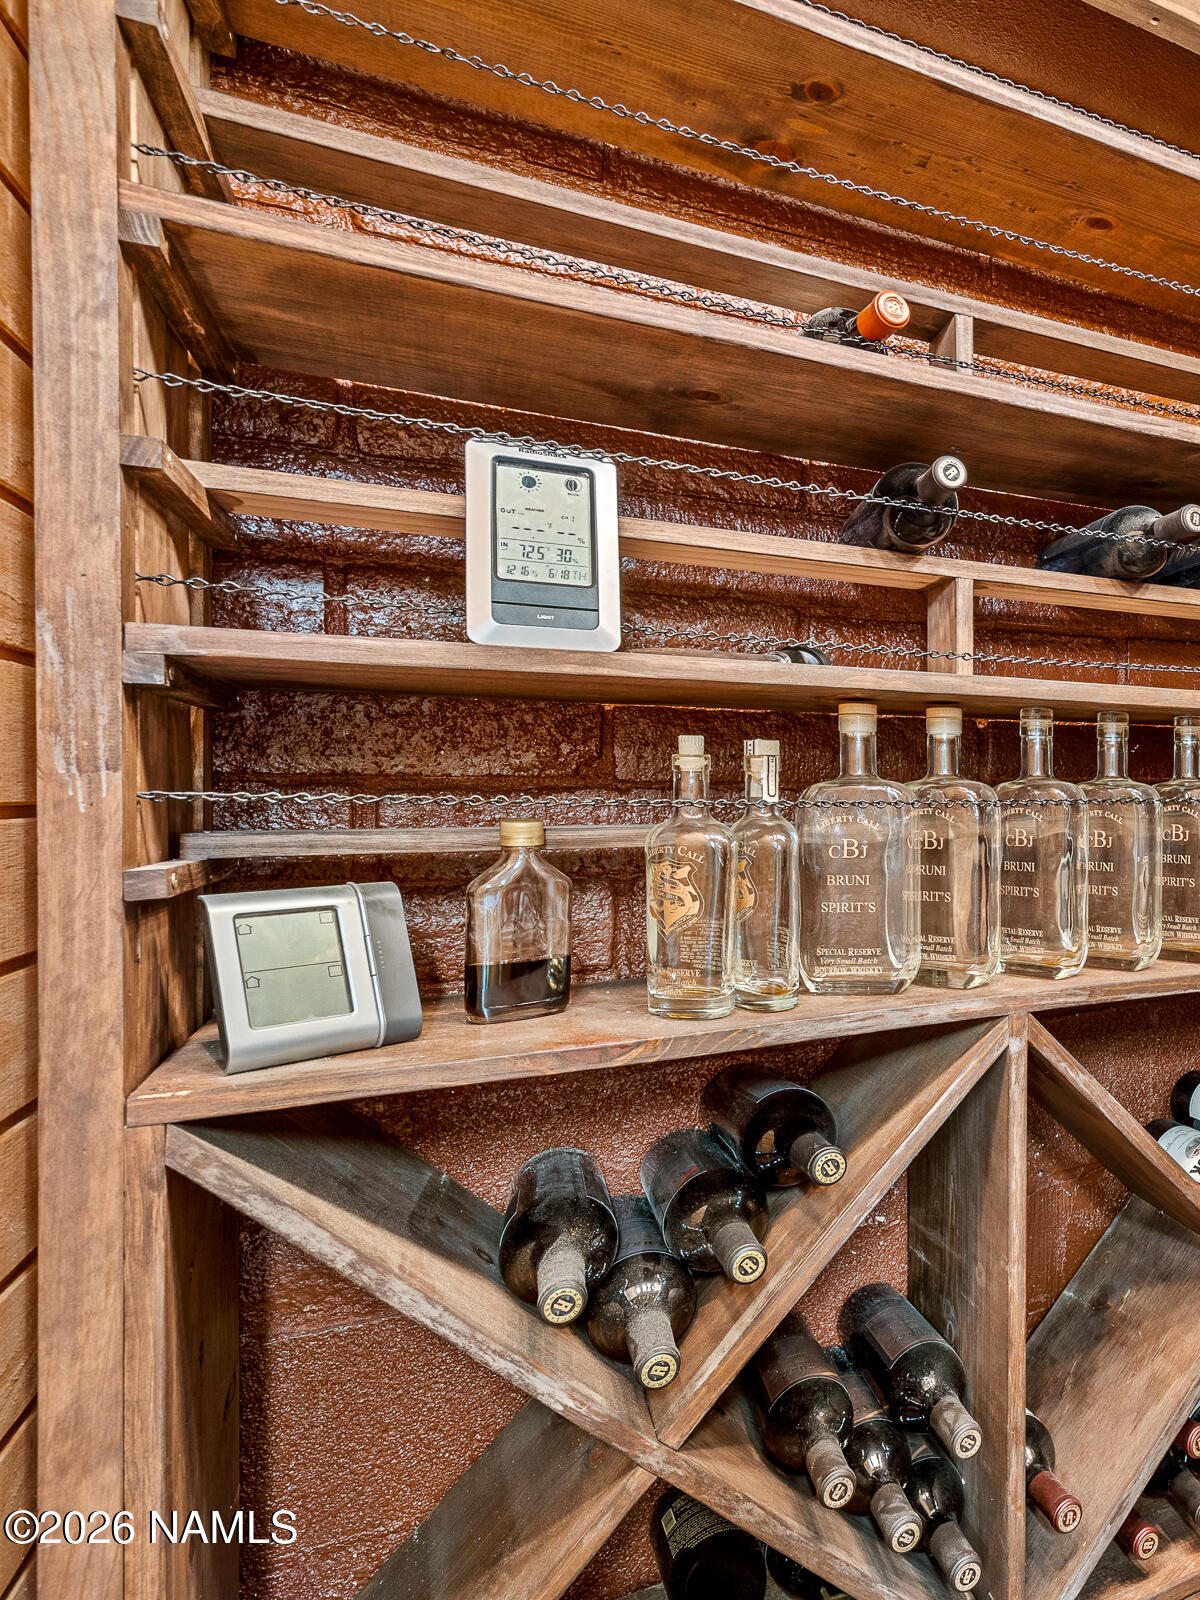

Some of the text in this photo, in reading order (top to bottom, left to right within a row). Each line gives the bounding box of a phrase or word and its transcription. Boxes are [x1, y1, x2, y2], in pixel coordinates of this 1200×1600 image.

[556, 548, 572, 563] 30
[935, 809, 955, 823] CALL
[1025, 808, 1043, 823] CALL
[1105, 811, 1123, 825] CALL
[1182, 806, 1199, 819] CALL
[815, 815, 880, 831] LIBERTY CALL
[677, 846, 704, 864] CALL
[1004, 861, 1035, 873] BRUNI
[1088, 862, 1114, 872] RUNI
[826, 874, 870, 886] BRUNI
[1162, 876, 1195, 887] PIRIT'S
[1000, 886, 1040, 898] SPIRIT'S
[821, 902, 876, 913] SPIRIT'S
[1175, 915, 1200, 924] RESERVE
[1018, 928, 1044, 938] RESERVE
[1096, 925, 1122, 934] RESERVE
[928, 935, 957, 944] RESERVE
[816, 947, 882, 956] SPECIAL RESERVE
[820, 957, 878, 966] Very Small Batch
